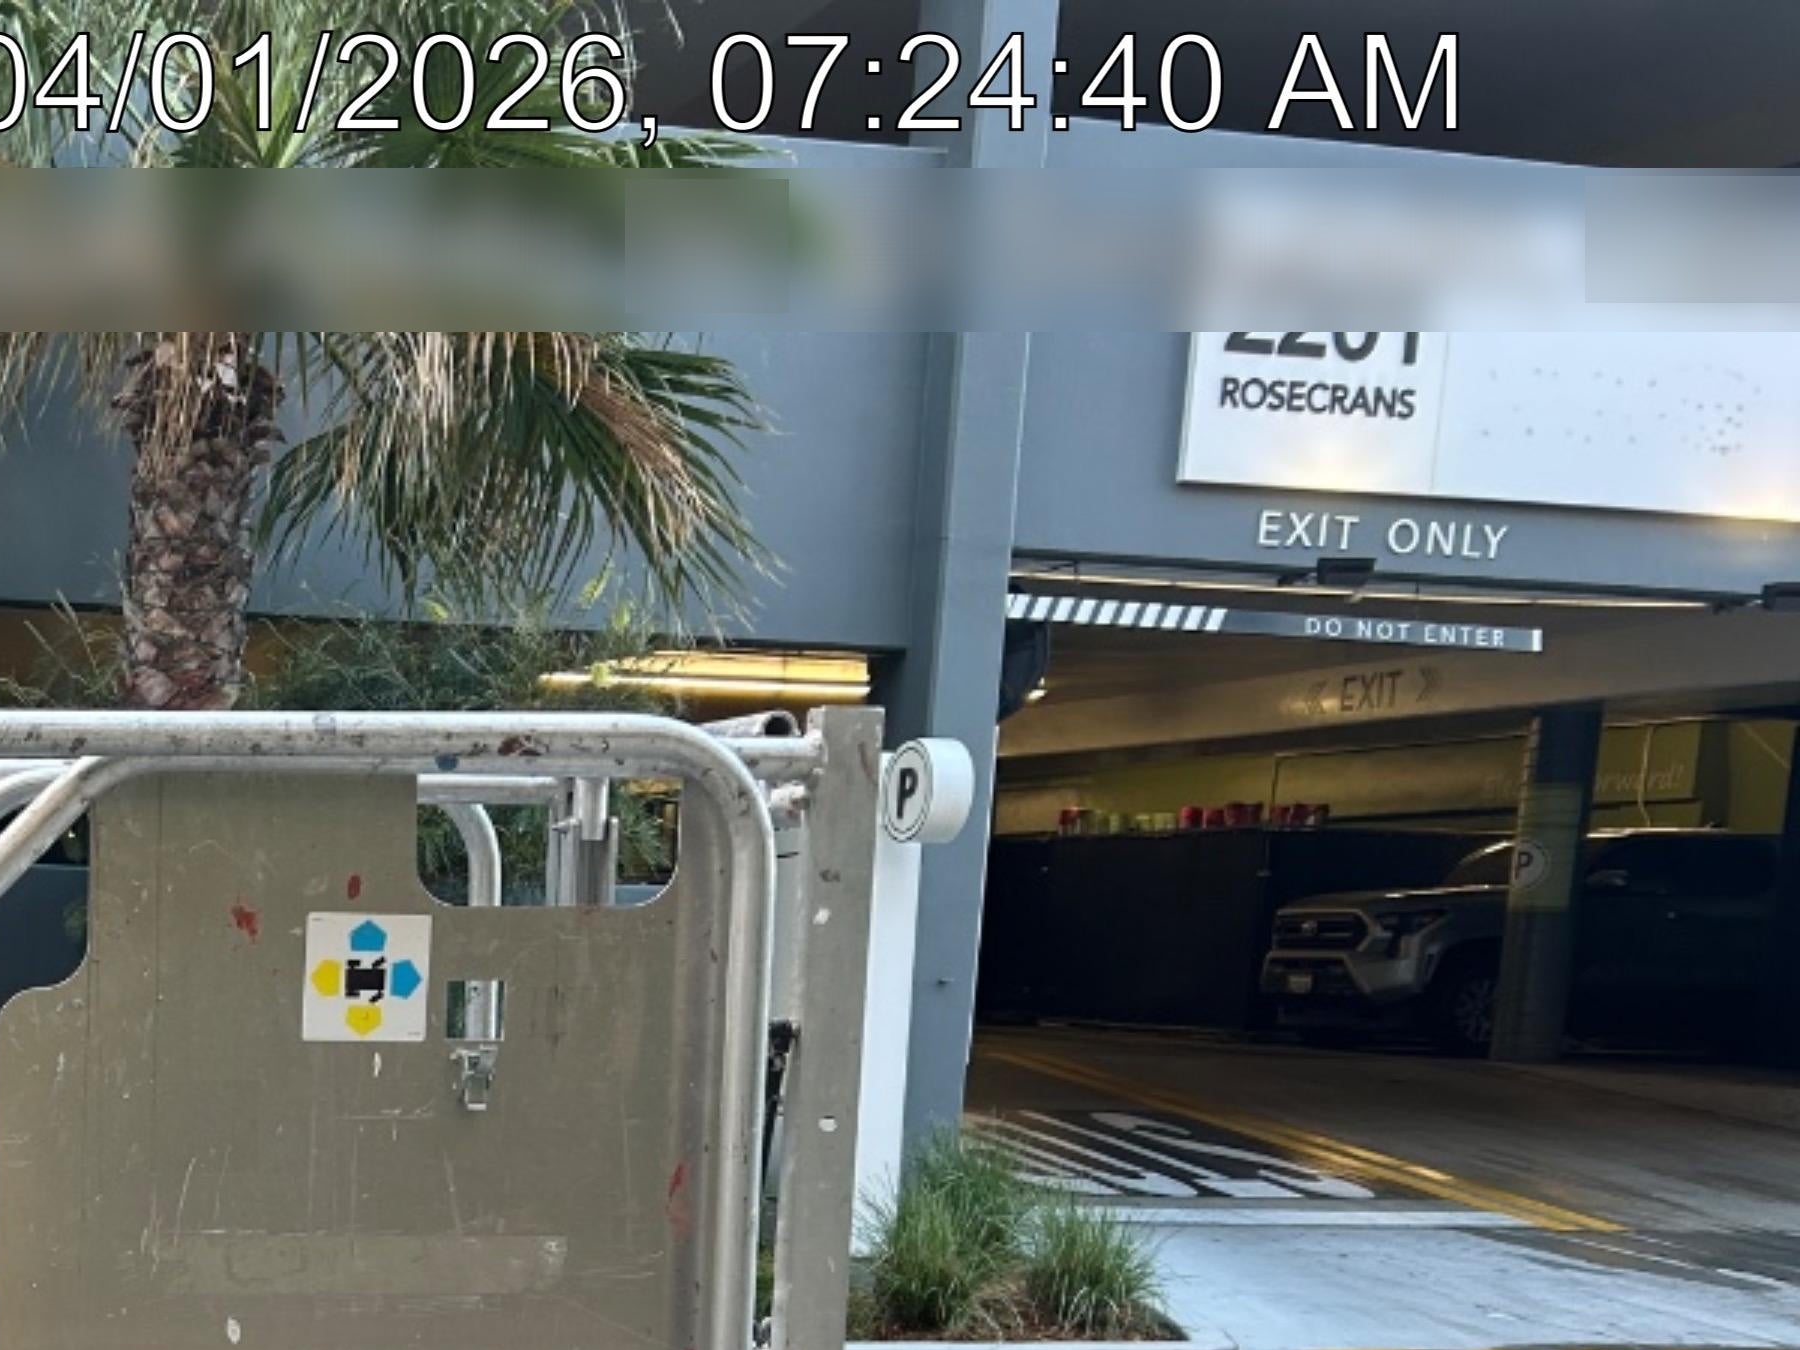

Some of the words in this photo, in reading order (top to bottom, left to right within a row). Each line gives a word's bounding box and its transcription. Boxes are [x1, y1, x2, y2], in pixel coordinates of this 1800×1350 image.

[1220, 376, 1417, 420] ROSECRANS
[1257, 509, 1360, 551] EXIT
[1387, 517, 1510, 560] ONLY
[1304, 616, 1343, 637] DO
[1357, 620, 1412, 641] NOT
[1423, 623, 1506, 647] ENTER
[1339, 669, 1404, 713] EXIT
[896, 766, 919, 820] P
[1514, 850, 1534, 881] P
